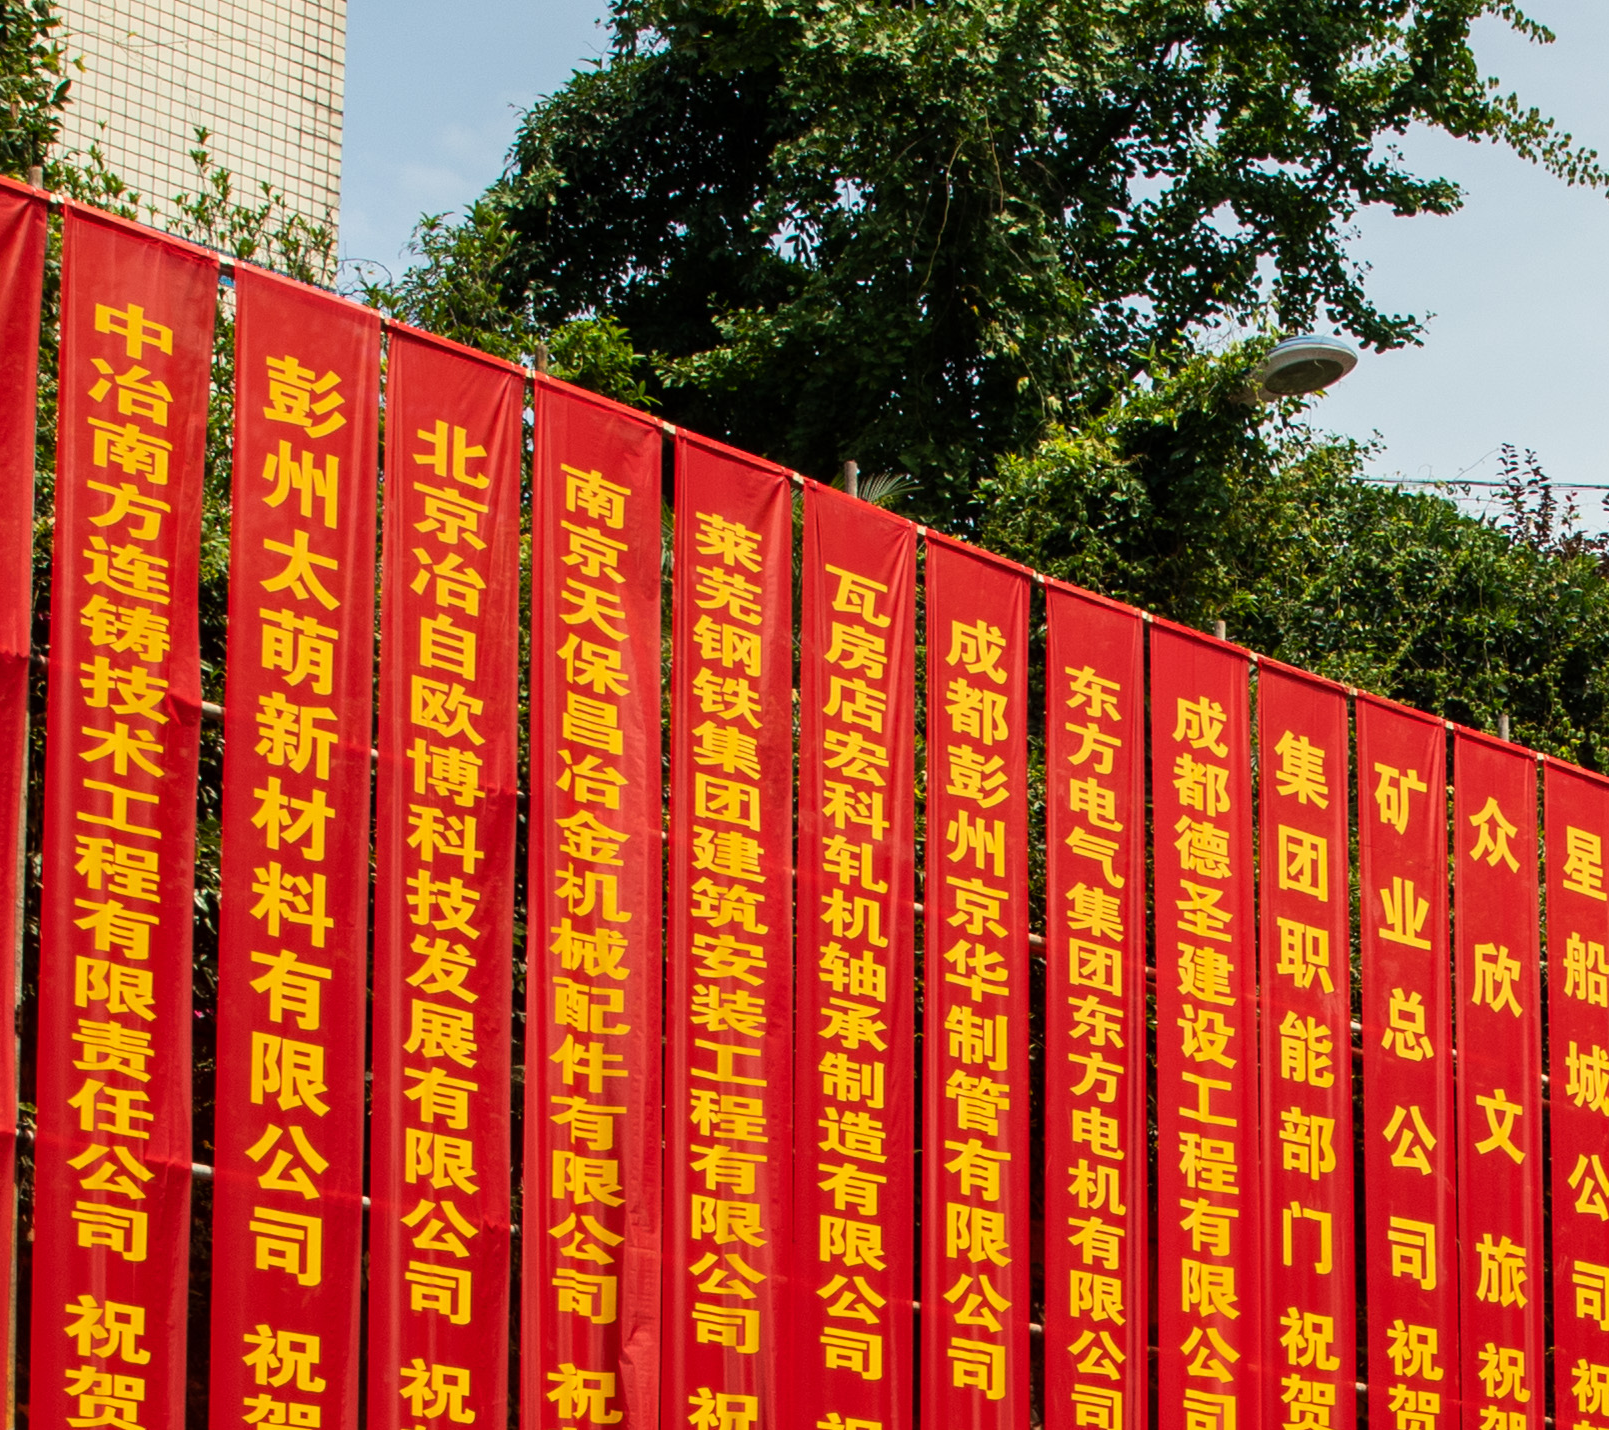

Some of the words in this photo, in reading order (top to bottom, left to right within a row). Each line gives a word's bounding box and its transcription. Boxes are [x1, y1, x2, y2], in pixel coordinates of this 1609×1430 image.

[68, 304, 173, 1261] 中冶南方连铸技术工程有限责任公司
[246, 356, 346, 1286] 彭州太萌新材料有限公司
[402, 420, 489, 1325] 北京冶自欧博科技发展有限公司
[549, 464, 631, 1324] 南京天保昌冶金机械配件有限公司
[690, 512, 768, 1354] 莱芜钢铁集团建筑安装工程有限公司
[817, 564, 890, 1380] 瓦房店宏科轧机轴承制造有限公司
[944, 620, 1011, 1400] 成都彭州京华制管有限公司
[1275, 731, 1336, 1274] 集团职能部门
[1375, 763, 1436, 1290] 矿业总公司
[1470, 797, 1527, 1307] 众欣文旅
